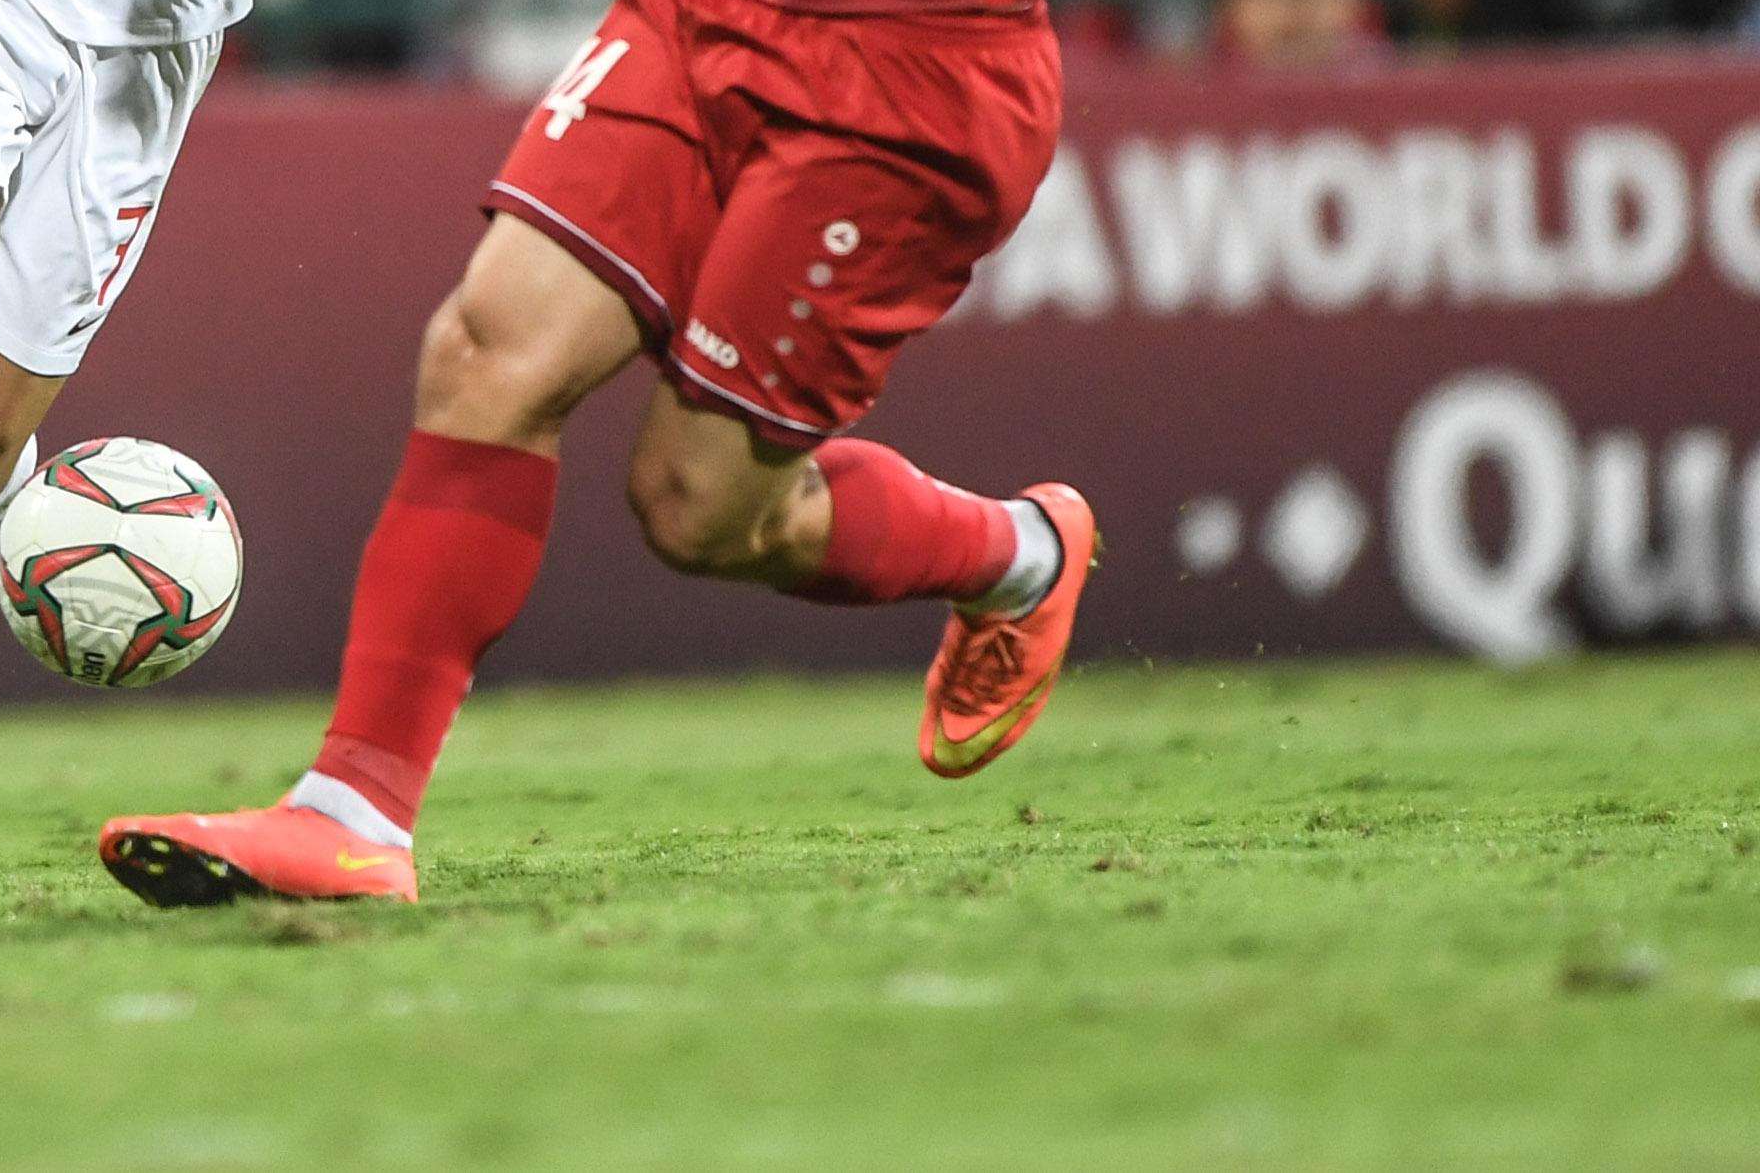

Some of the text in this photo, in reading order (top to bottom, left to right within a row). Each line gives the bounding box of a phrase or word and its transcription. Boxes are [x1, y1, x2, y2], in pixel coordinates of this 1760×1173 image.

[97, 206, 154, 306] 7
[1111, 126, 1691, 312] WORLD
[1395, 376, 1760, 666] Qu
